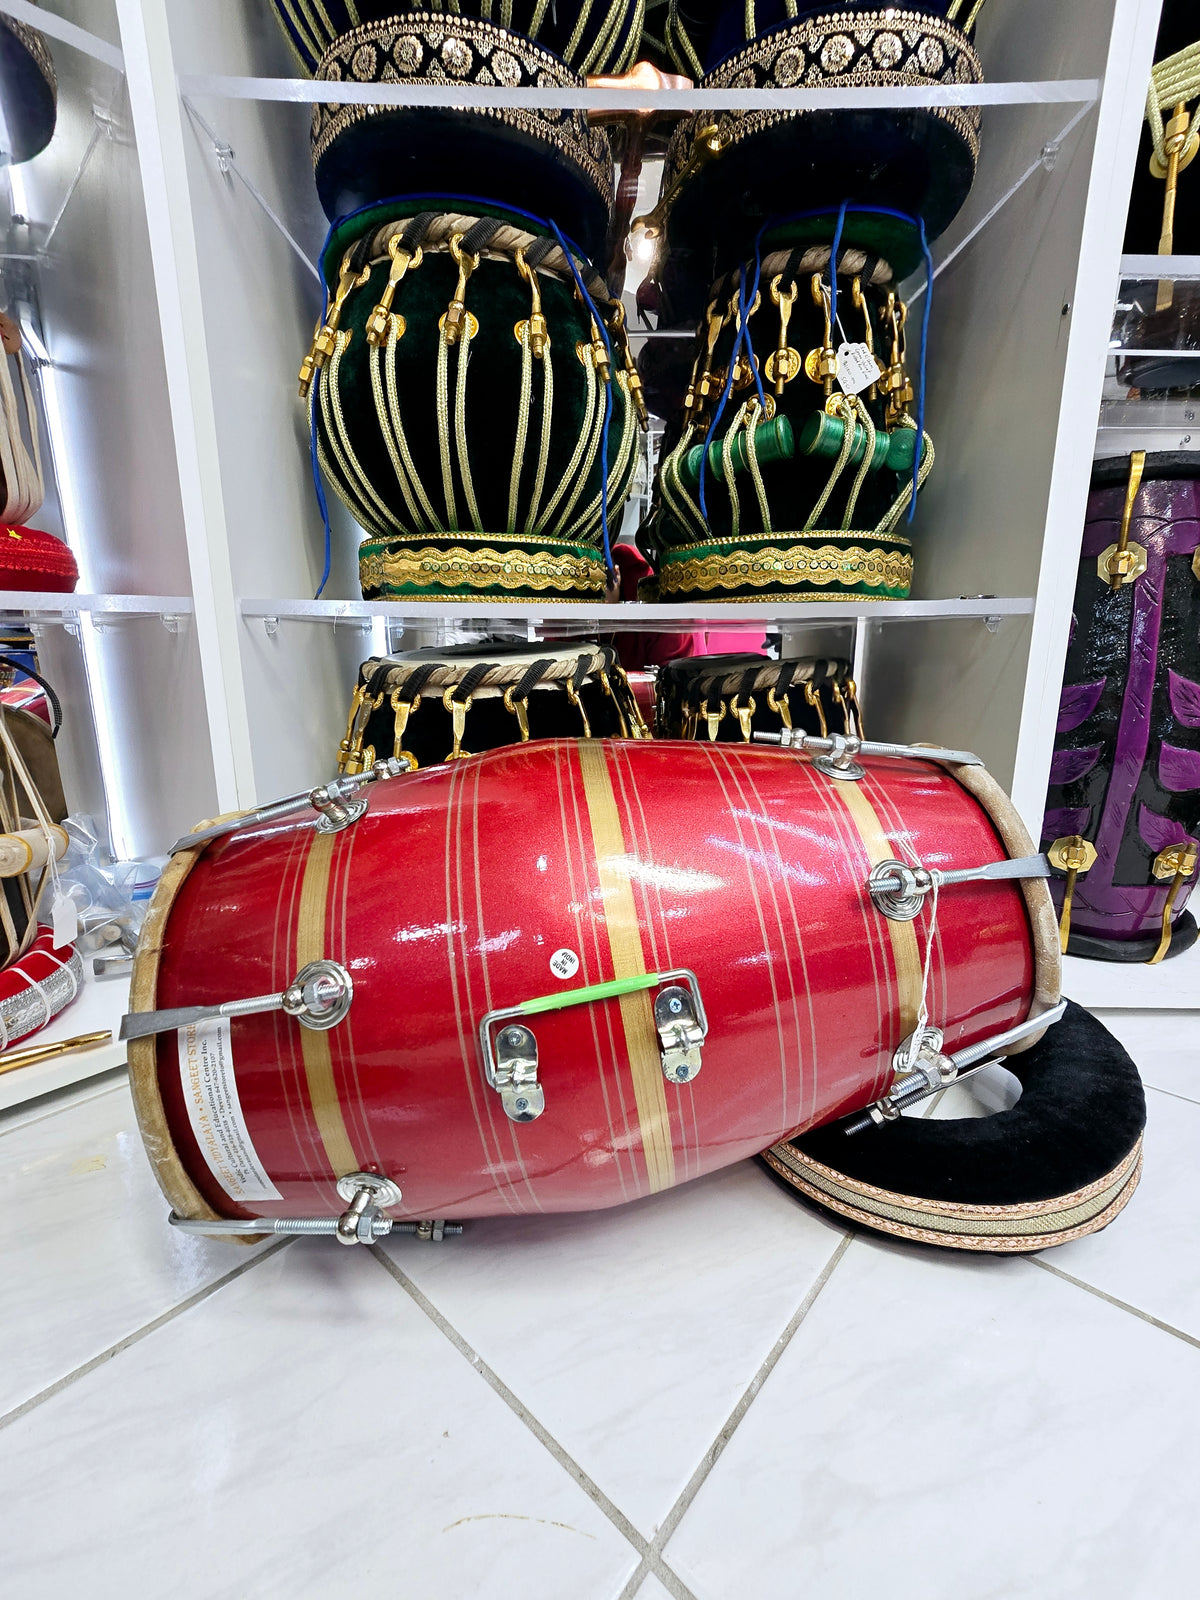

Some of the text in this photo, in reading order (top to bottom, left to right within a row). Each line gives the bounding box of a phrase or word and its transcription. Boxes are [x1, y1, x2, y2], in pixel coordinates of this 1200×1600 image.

[552, 960, 568, 975] MADE
[560, 958, 568, 966] IN
[561, 952, 576, 965] INDIA
[202, 1056, 211, 1083] Centre
[187, 1058, 204, 1105] SANGEET
[205, 1084, 222, 1128] Educational
[217, 1094, 226, 1114] Devin
[199, 1115, 225, 1165] VIDYALAYA
[216, 1128, 227, 1143] and
[222, 1142, 238, 1168] Cultural
